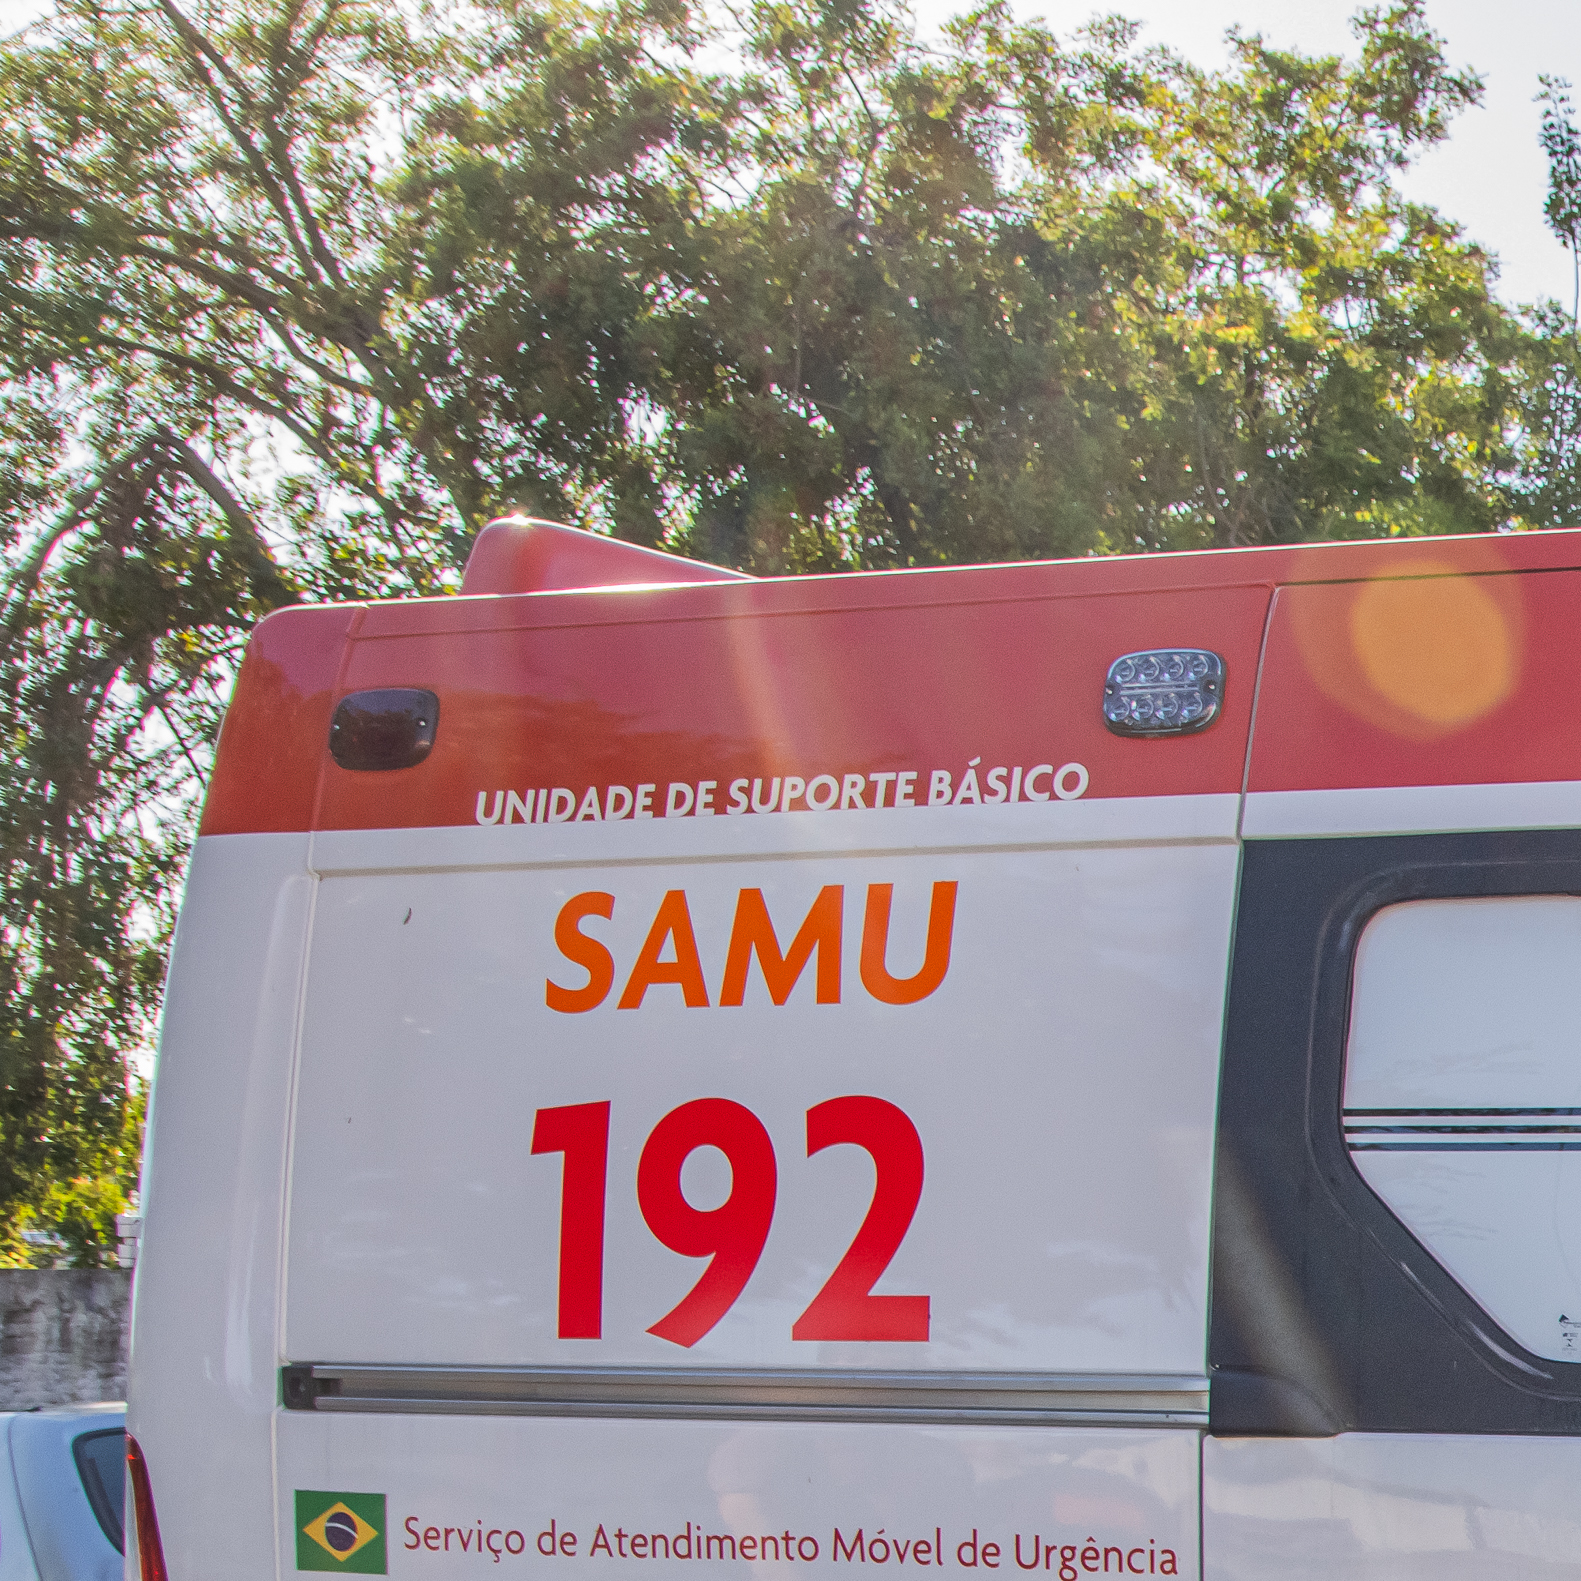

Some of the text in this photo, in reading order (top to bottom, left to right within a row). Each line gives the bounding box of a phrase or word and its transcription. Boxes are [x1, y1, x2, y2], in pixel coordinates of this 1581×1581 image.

[475, 756, 1090, 826] UNIDADE DE SUPORTE BÁSICO
[546, 881, 958, 1013] SAMU
[530, 1095, 930, 1348] 192
[404, 1516, 526, 1563] Serviço
[537, 1519, 578, 1557] de
[590, 1521, 821, 1562] Atendimento
[833, 1528, 944, 1566] Móvel
[956, 1528, 1002, 1569] de
